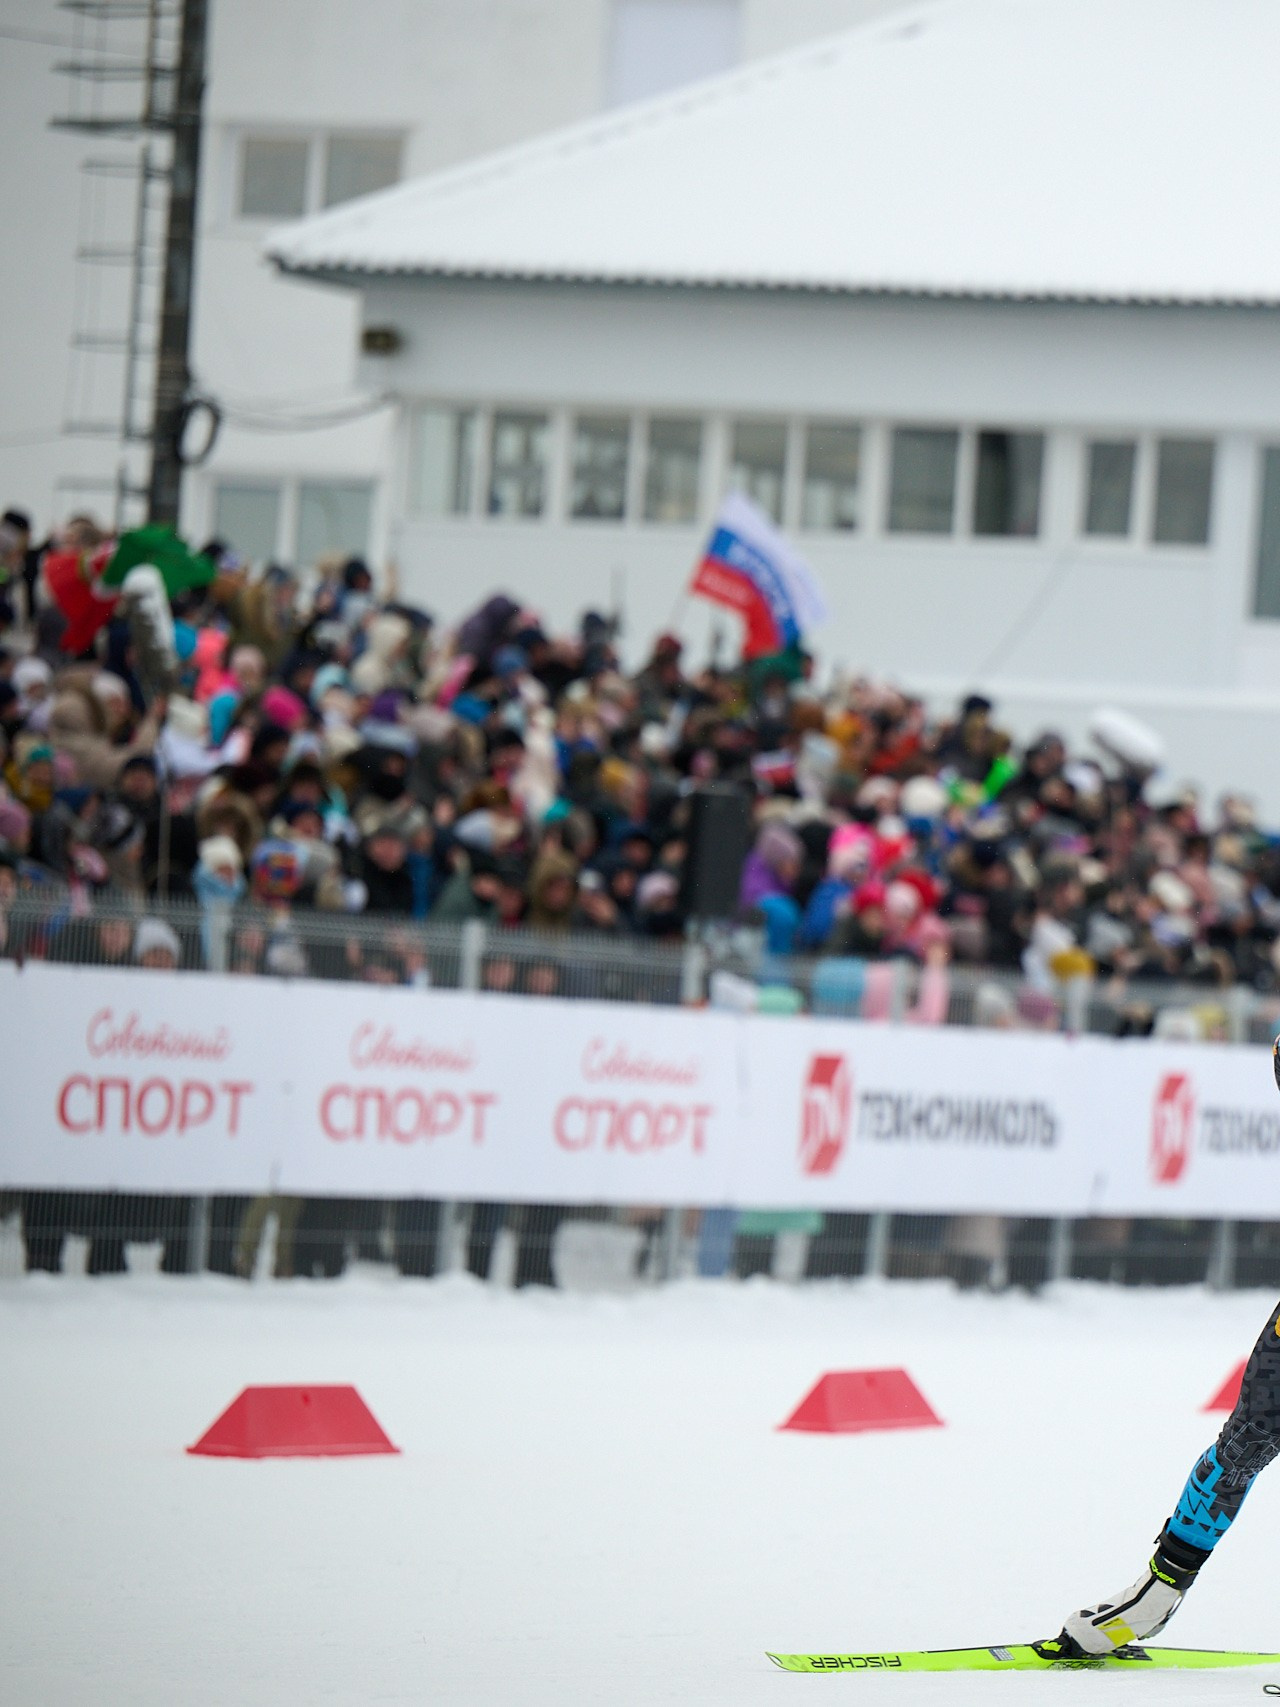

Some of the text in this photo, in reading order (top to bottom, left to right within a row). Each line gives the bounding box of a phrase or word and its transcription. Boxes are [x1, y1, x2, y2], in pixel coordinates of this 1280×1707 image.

[57, 1073, 254, 1138] СПОРТ
[319, 1083, 496, 1146] СПОРТ
[553, 1096, 714, 1154] СПОРТ
[808, 1655, 902, 1669] FISCHER
